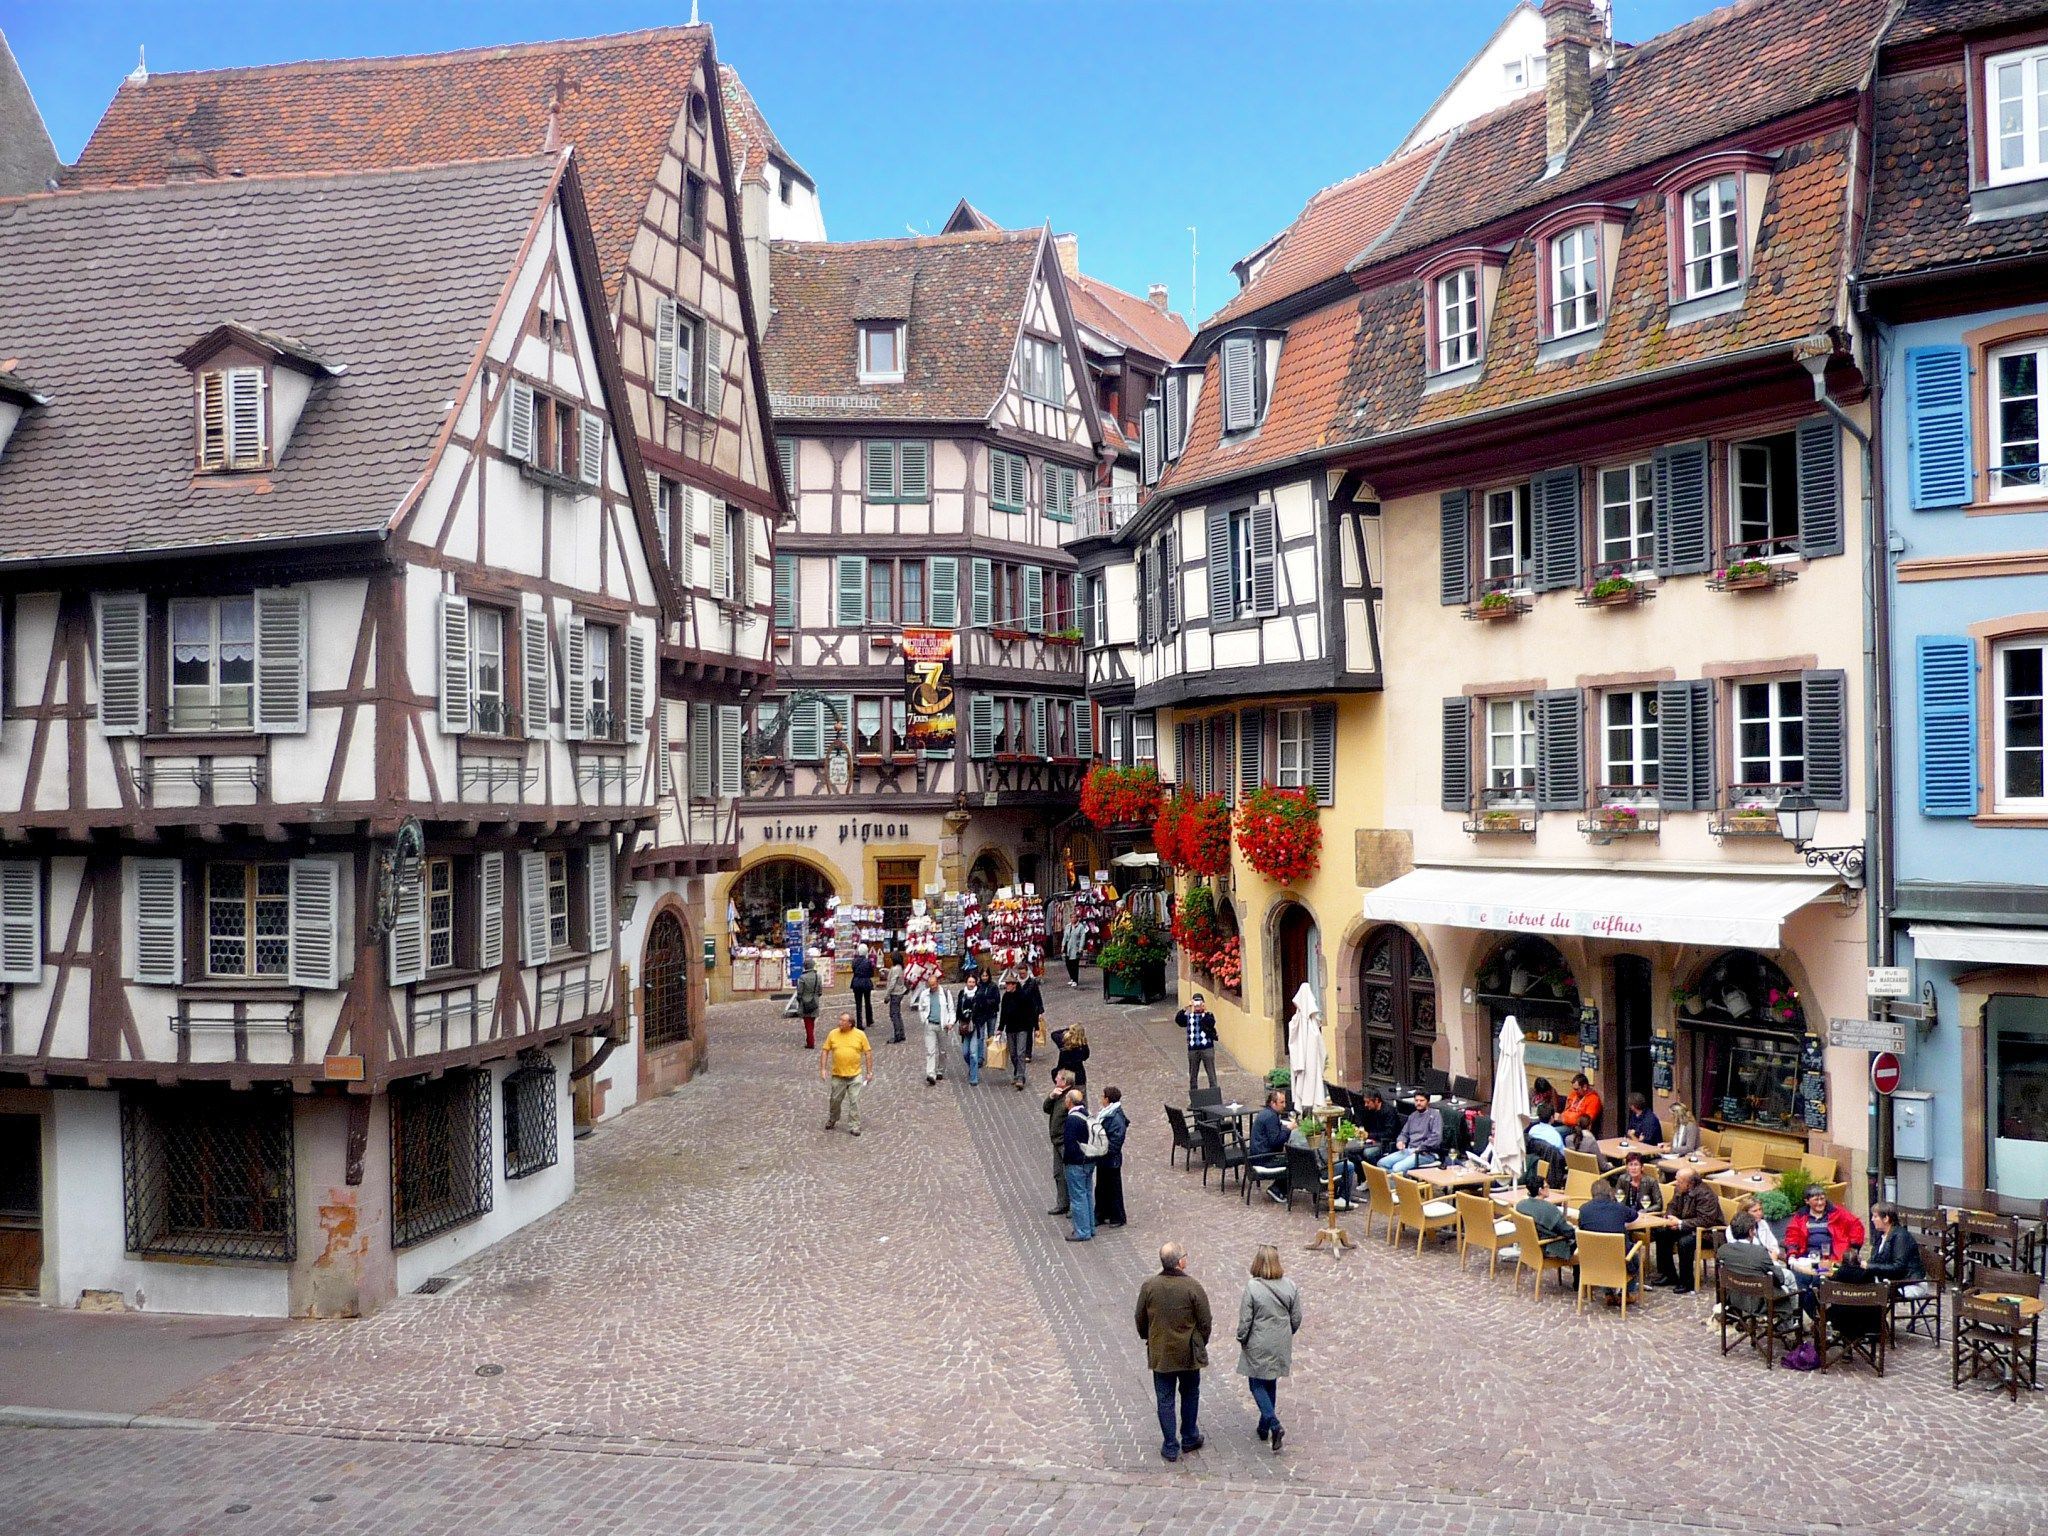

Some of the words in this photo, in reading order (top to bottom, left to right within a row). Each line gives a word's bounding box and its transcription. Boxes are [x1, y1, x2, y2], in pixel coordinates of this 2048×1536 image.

[838, 817, 909, 844] pignon
[1550, 912, 1570, 929] du
[1831, 1289, 1842, 1297] LE
[1843, 1290, 1878, 1298] MURPHY'S
